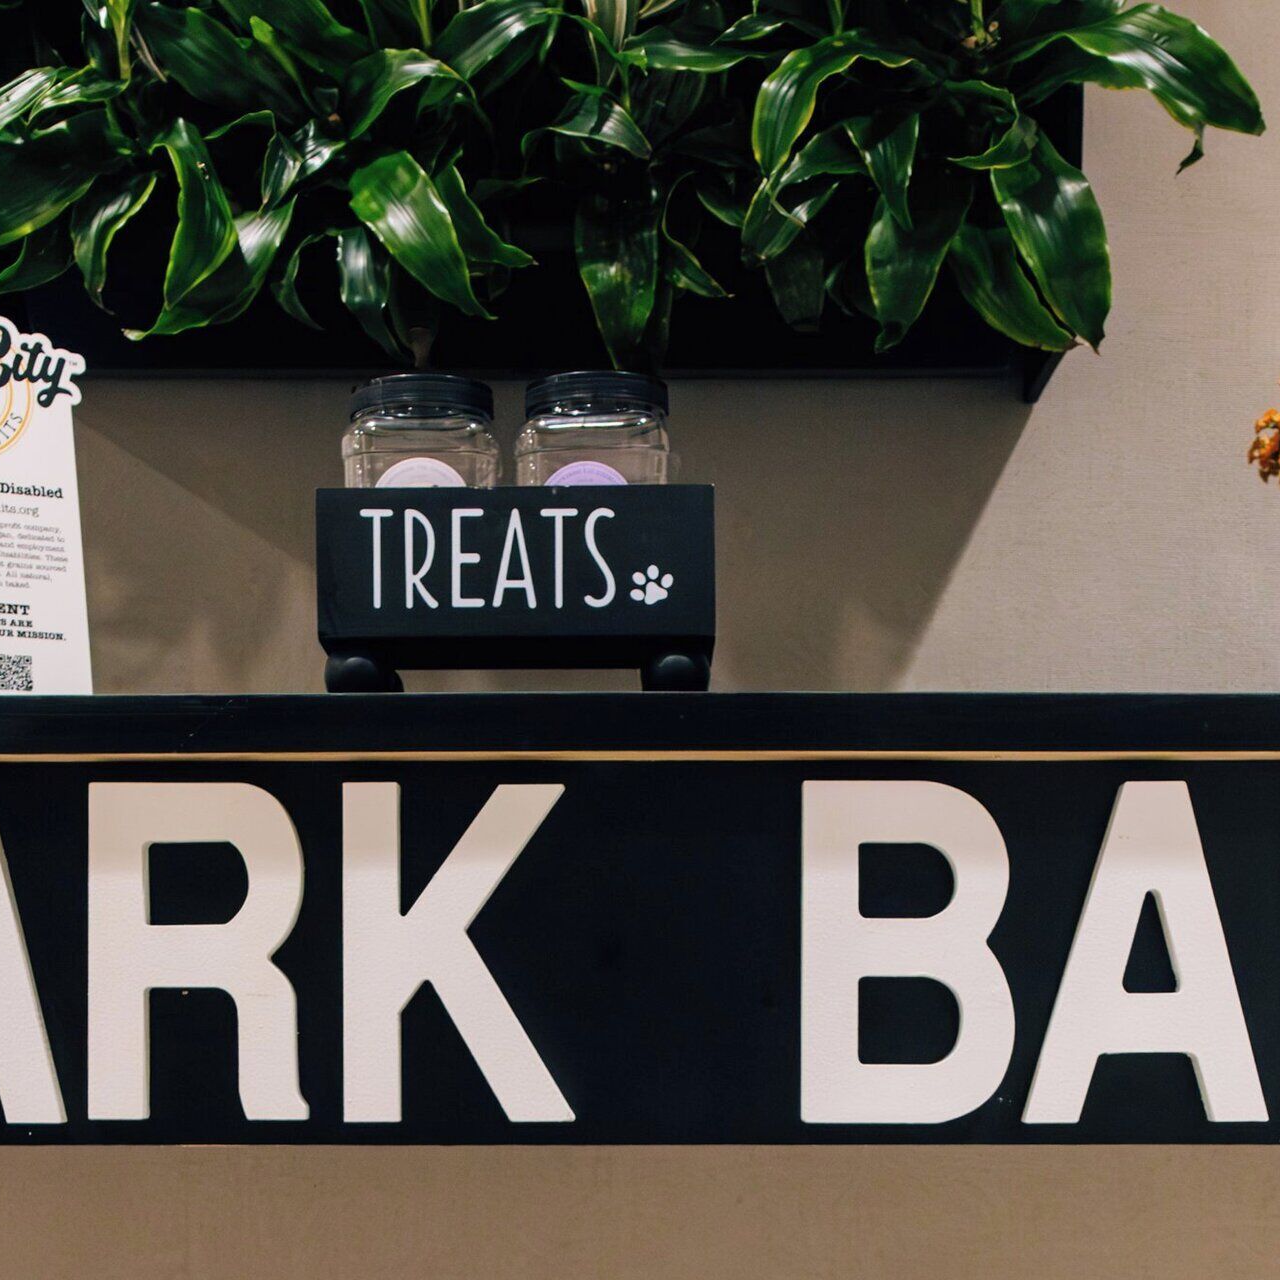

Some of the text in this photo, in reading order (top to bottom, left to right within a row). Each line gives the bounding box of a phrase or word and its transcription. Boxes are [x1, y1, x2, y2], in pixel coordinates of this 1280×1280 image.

[0, 482, 63, 499] Disabled
[358, 506, 617, 609] TREATS
[9, 619, 33, 628] ARE
[17, 630, 67, 641] MISSION.
